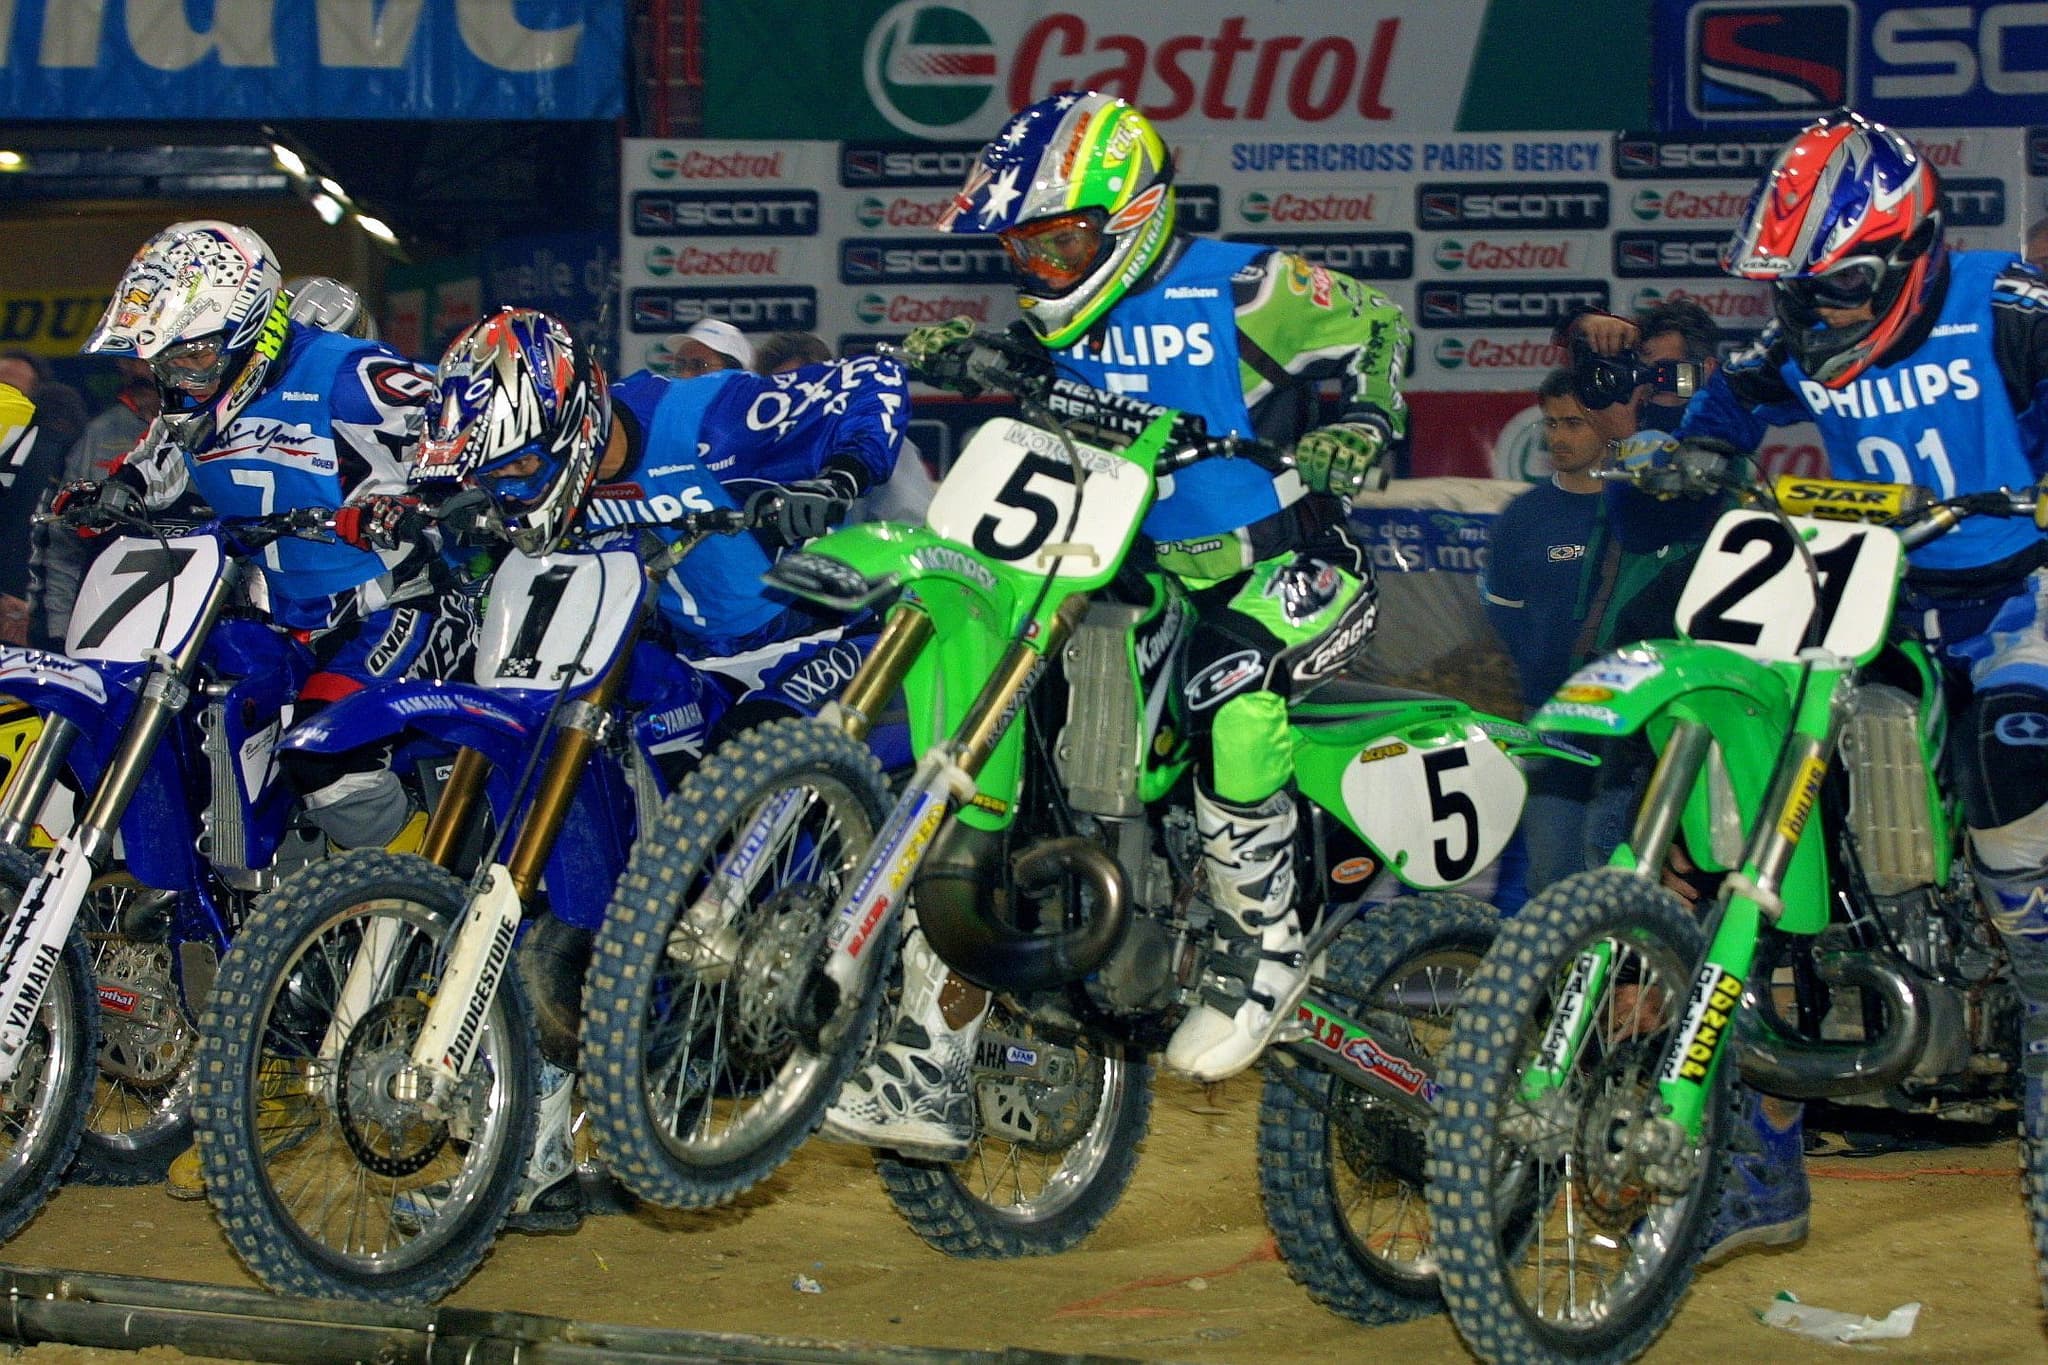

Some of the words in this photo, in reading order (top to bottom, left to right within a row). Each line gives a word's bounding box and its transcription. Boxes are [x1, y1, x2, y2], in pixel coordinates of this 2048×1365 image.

[1008, 13, 1397, 121] Castrol
[681, 151, 784, 179] Castrol
[1232, 143, 1413, 172] SUPERCROSS
[1424, 143, 1503, 172] PARIS
[1512, 143, 1599, 171] BERCY
[674, 202, 812, 225] SCOTT
[1271, 193, 1376, 222] Castrol
[1462, 195, 1602, 218] SCOTT
[676, 246, 780, 276] Castrol
[1467, 241, 1570, 270] Castrol
[673, 299, 809, 322] SCOTT
[410, 464, 460, 479] SHARK
[972, 451, 1092, 561] 5
[1786, 484, 1888, 505] STAR
[77, 549, 197, 650] 7
[1687, 518, 1868, 656] 21
[495, 565, 577, 678] 1
[782, 641, 863, 704] OXBO
[389, 695, 458, 715] YAMAHA
[1422, 746, 1478, 882] 5
[7, 943, 60, 1029] YAMAHA
[450, 915, 516, 1075] BRIDGESTONE
